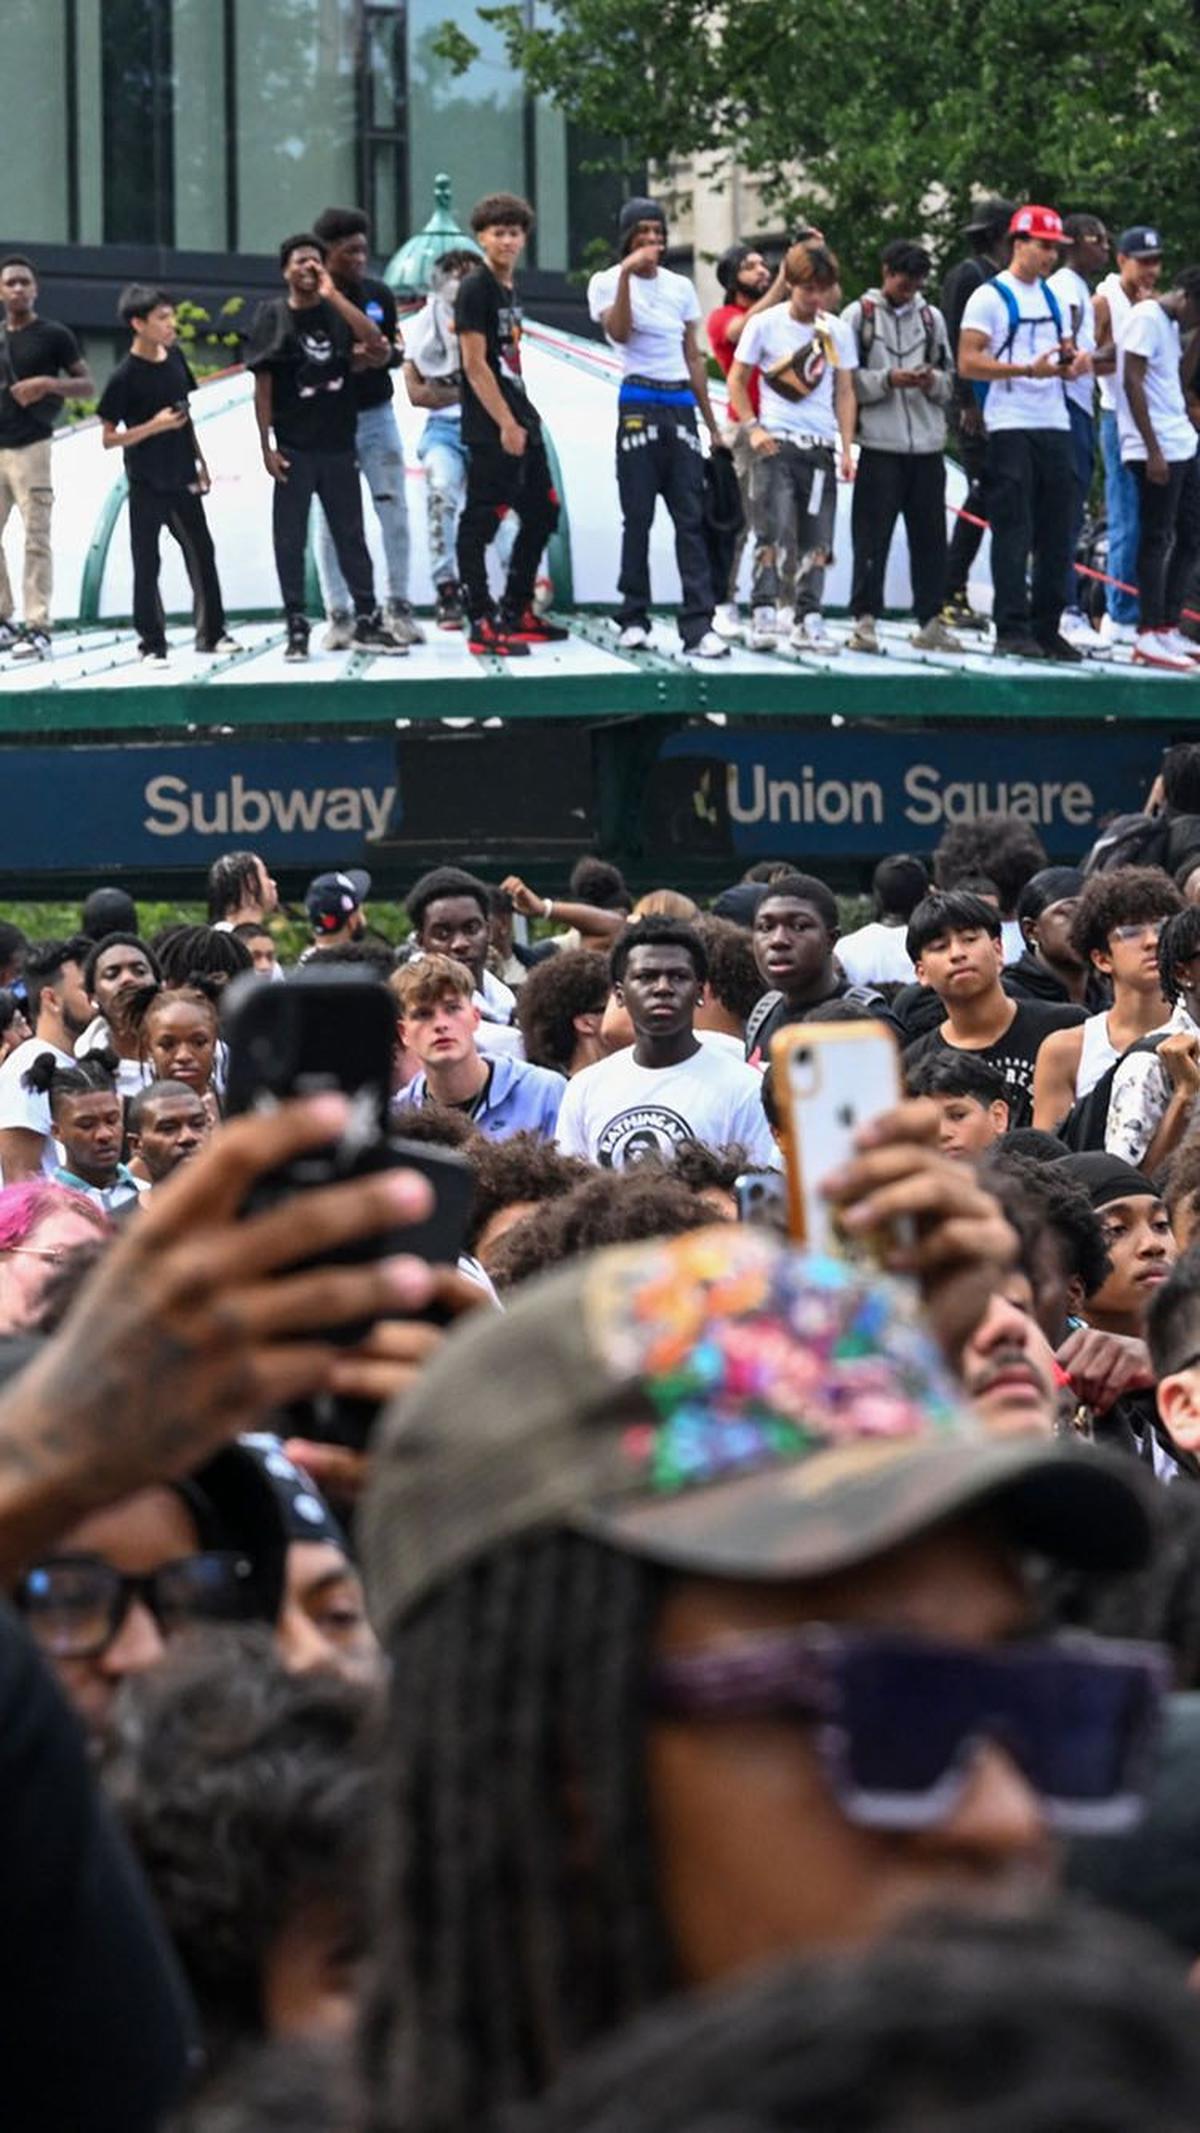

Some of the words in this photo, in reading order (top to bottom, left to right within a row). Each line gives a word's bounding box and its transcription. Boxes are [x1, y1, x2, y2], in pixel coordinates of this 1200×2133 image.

[144, 774, 397, 841] Subway
[727, 764, 884, 824] Union
[904, 763, 1095, 825] Square
[600, 1112, 667, 1153] BATHING
